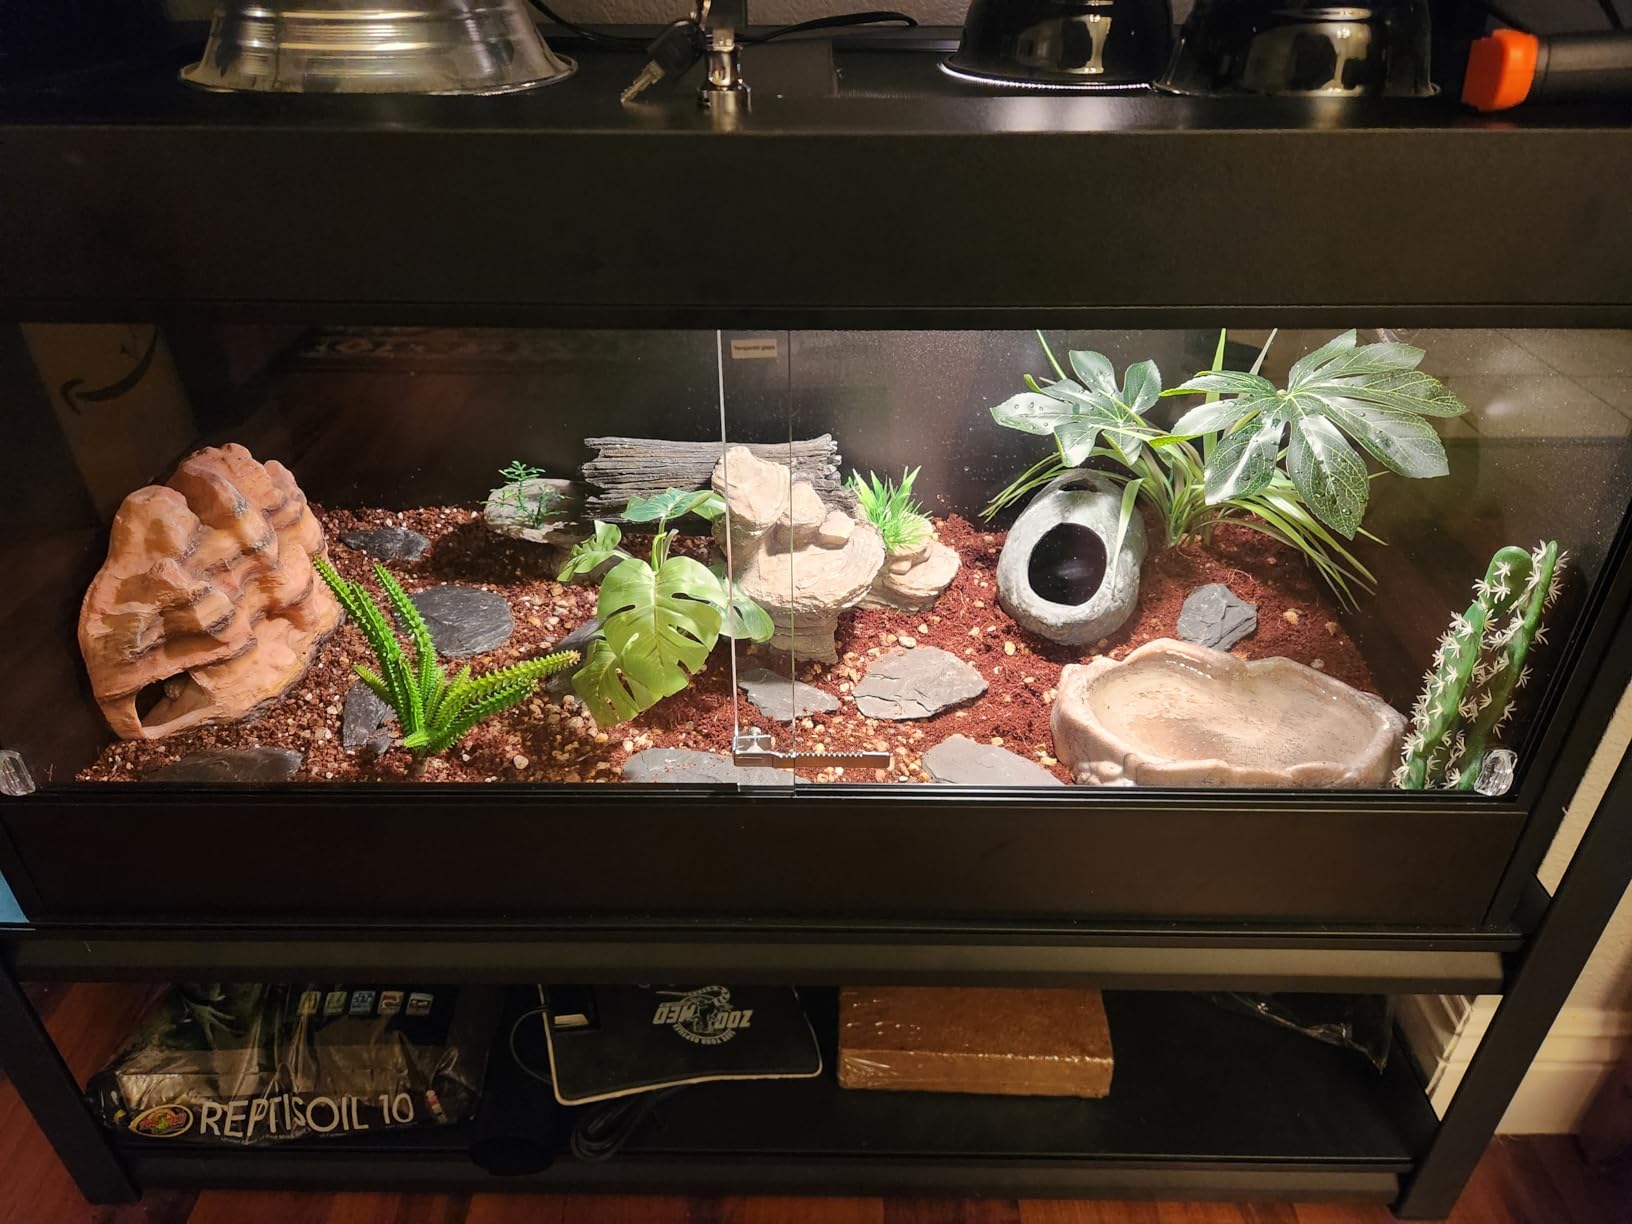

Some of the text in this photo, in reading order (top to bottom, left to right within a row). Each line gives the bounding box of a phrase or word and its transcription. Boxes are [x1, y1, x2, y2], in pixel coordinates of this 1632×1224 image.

[653, 1004, 753, 1029] ZOO MED
[200, 1093, 415, 1138] REPTISOIL 10
